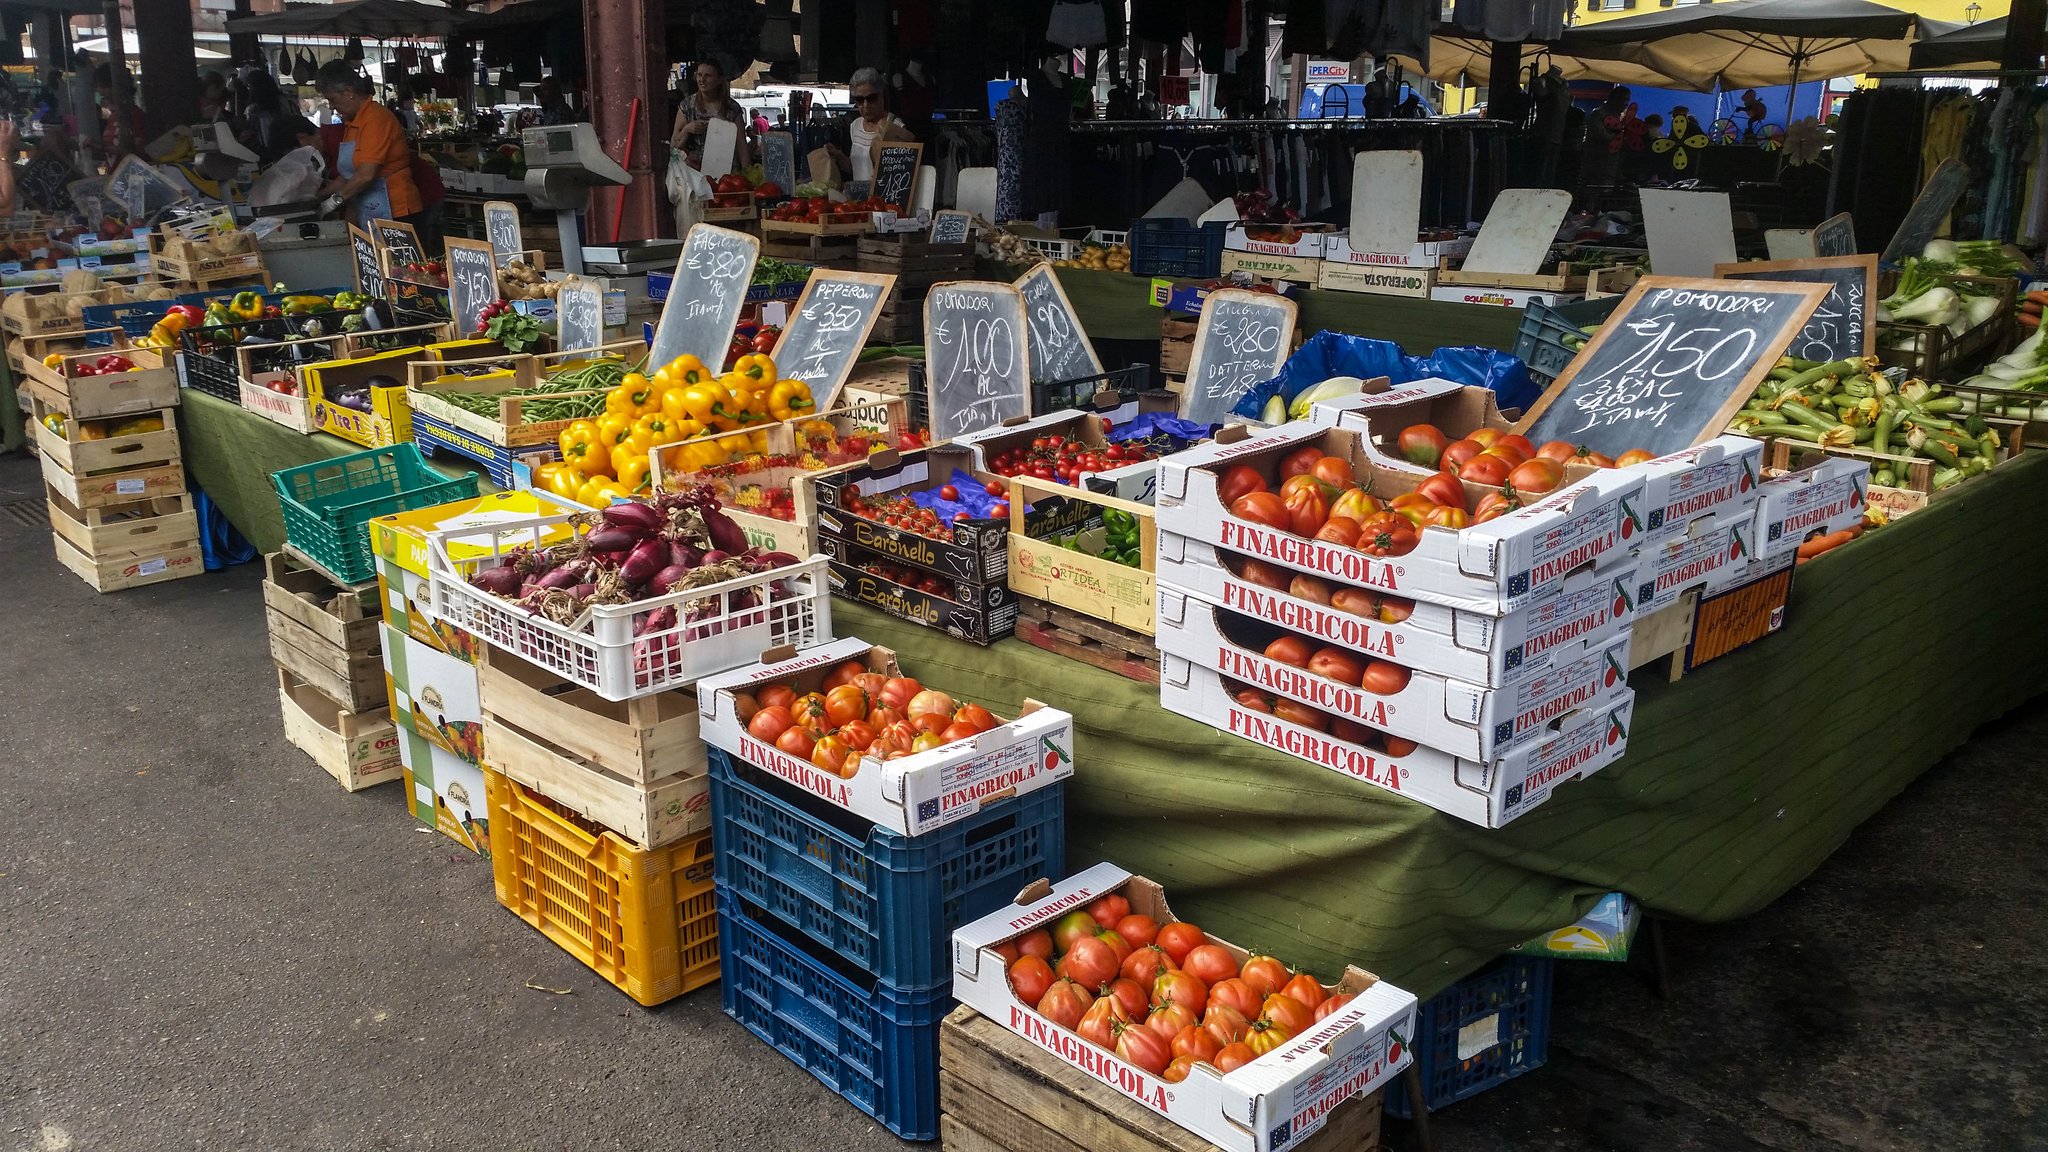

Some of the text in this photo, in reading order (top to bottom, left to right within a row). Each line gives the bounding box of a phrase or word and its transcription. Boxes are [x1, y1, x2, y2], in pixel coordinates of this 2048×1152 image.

[199, 261, 225, 271] ASTA
[1246, 242, 1297, 255] FINAGRICOLA
[1350, 252, 1409, 265] FINAGRICOLA
[935, 292, 995, 313] POMODORI
[1364, 273, 1423, 290] COFERASTA
[1652, 288, 1774, 314] POMODORI
[41, 318, 71, 329] ASTA
[1666, 483, 1733, 522] FINAGRICOLA
[1783, 500, 1844, 534] FINAGRICOLA
[854, 521, 936, 565] Baronello
[1220, 520, 1398, 591] FINAGRICOLA
[1531, 531, 1615, 587] FINAGRICOLA
[1655, 552, 1723, 592] FINAGRICOLA
[858, 577, 939, 623] Baronello
[1222, 581, 1397, 657] FINAGRICOLA
[1524, 608, 1606, 658] FINAGRICOLA
[749, 653, 832, 680] FINAGRICOLA
[1218, 647, 1389, 727] FINAGRICOLA
[1515, 680, 1596, 733] FINAGRICOLA
[739, 736, 850, 807] FINAGRICOLA
[1228, 708, 1401, 790] FINAGRICOLA
[1524, 740, 1600, 794] FINAGRICOLA
[941, 763, 1036, 811] FINAGRICOLA
[1009, 888, 1092, 930] FINAGRICOLA
[1280, 1009, 1366, 1060] FINAGRICOLA
[1010, 1005, 1169, 1114] FINAGRICOLA
[1292, 1060, 1381, 1134] FINAGRICOLA
